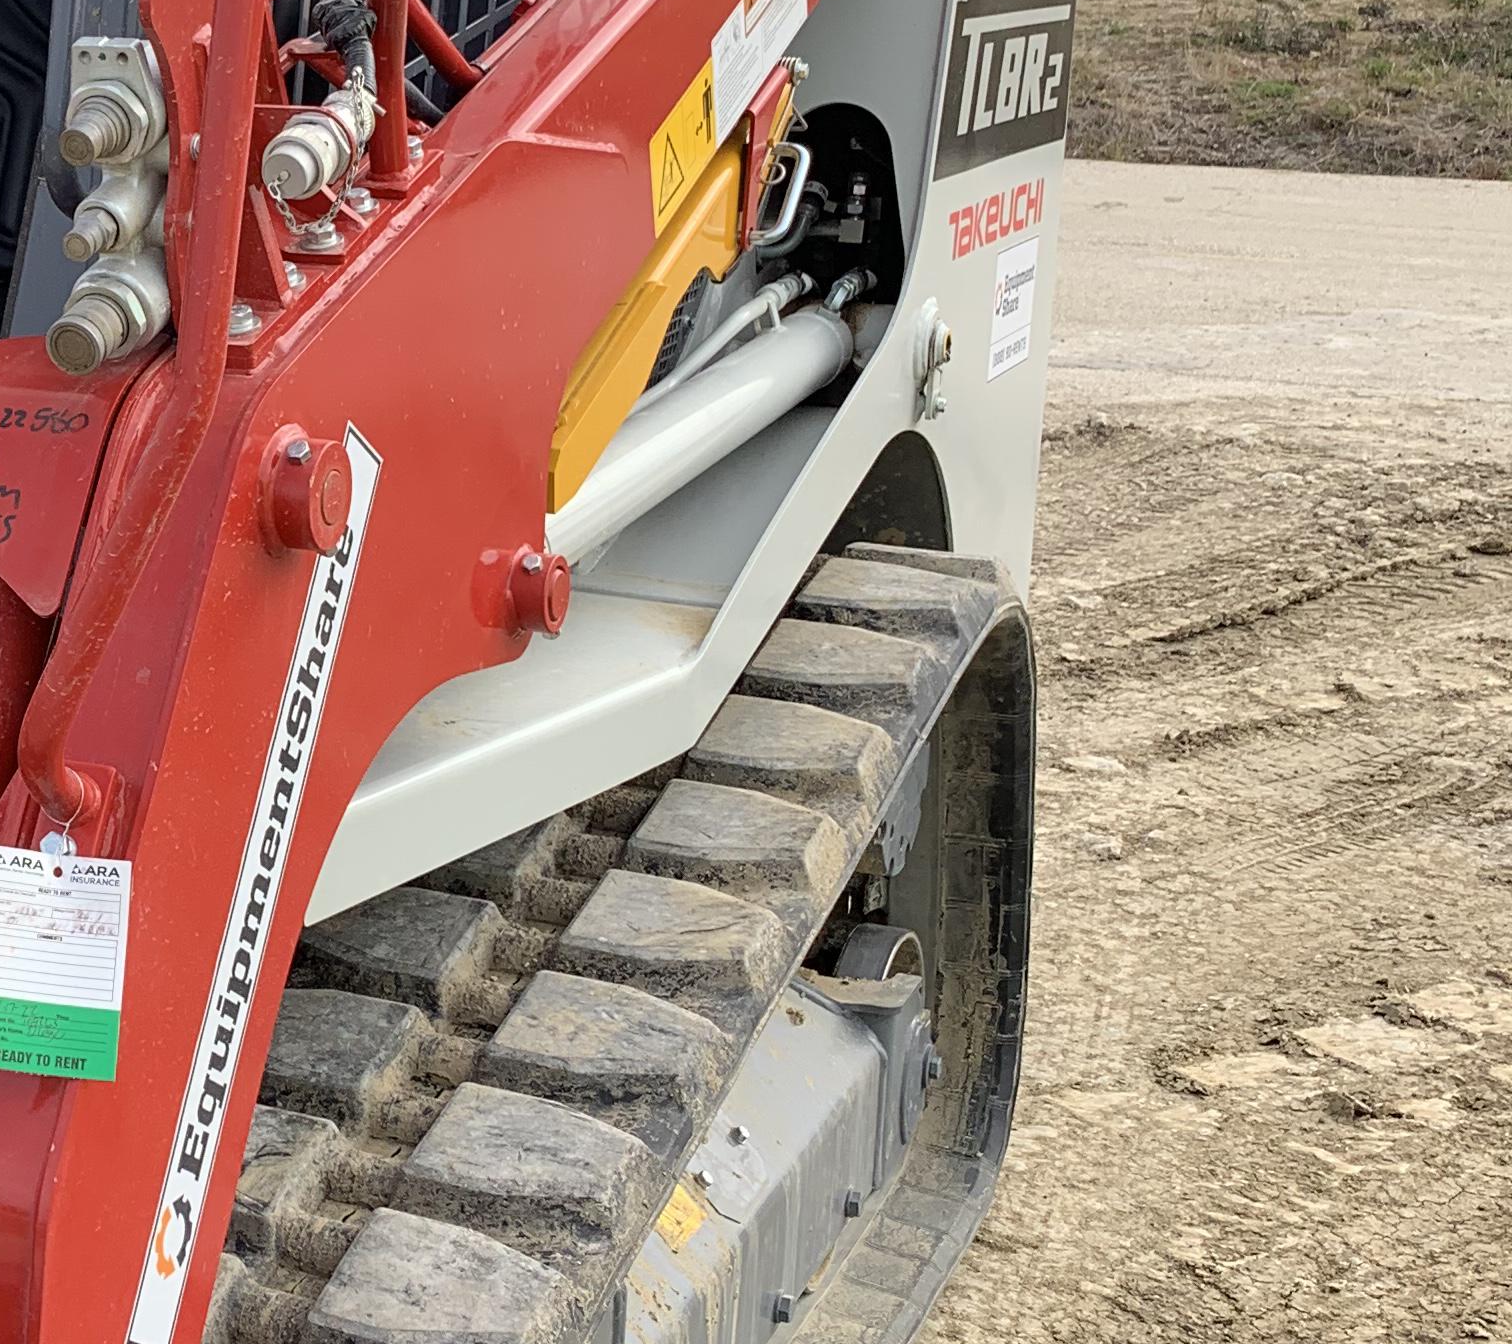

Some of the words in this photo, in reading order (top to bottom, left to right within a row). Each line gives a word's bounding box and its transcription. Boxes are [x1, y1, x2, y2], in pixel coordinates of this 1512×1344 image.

[177, 523, 354, 1181] EquipmentShare
[9, 855, 44, 872] ARA
[85, 864, 120, 878] ARA
[69, 875, 120, 887] INSURANCE
[35, 1053, 50, 1067] TO
[54, 1057, 87, 1071] RENT
